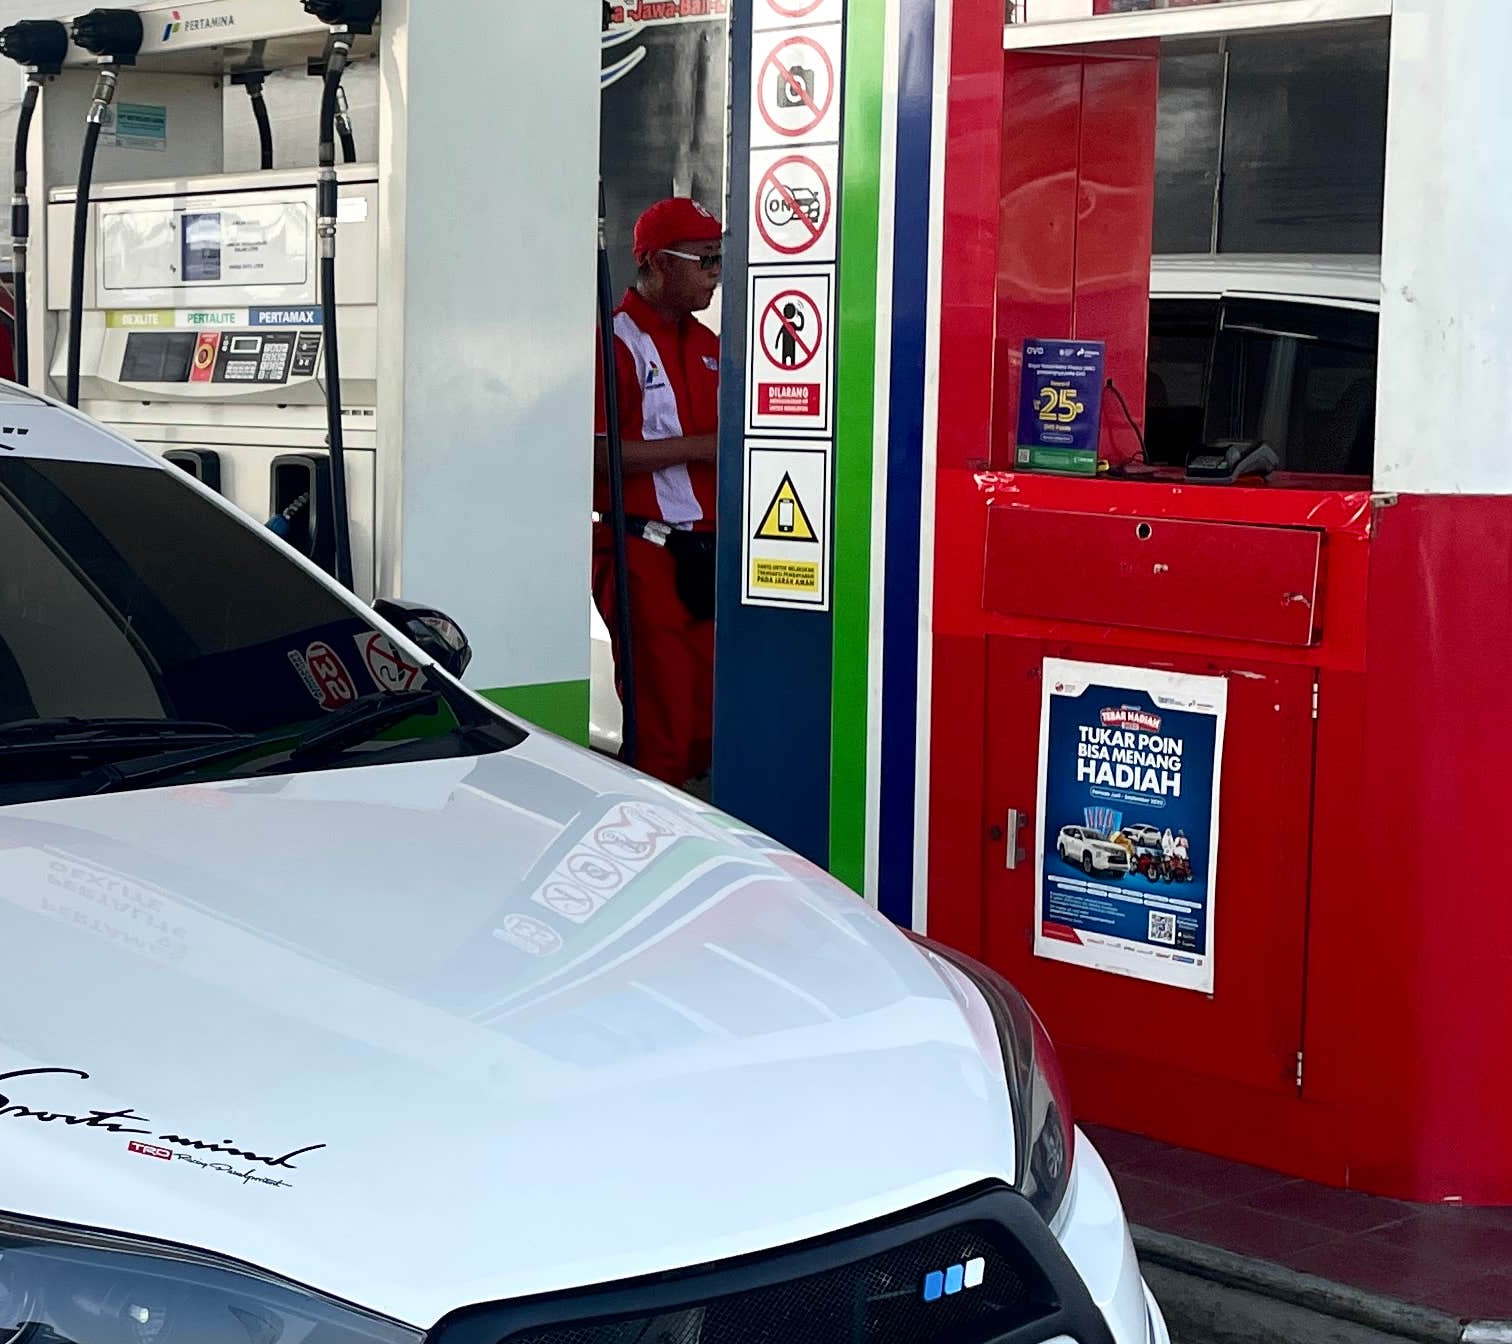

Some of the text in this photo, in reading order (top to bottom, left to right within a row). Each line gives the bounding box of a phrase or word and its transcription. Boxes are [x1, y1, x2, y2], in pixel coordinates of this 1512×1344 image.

[184, 15, 235, 32] PERTAMINA
[769, 199, 791, 213] ON
[122, 313, 159, 325] DEXLITE
[187, 311, 236, 325] PERTALITE
[258, 310, 314, 323] PERTAMAX
[768, 386, 809, 398] DILARANG
[1039, 387, 1077, 422] 25
[1078, 725, 1136, 749] TUKAR
[1138, 733, 1183, 756] POIN
[1077, 743, 1182, 772] BISA MENANG
[1077, 758, 1182, 797] HADIAH
[129, 1141, 172, 1160] TRD
